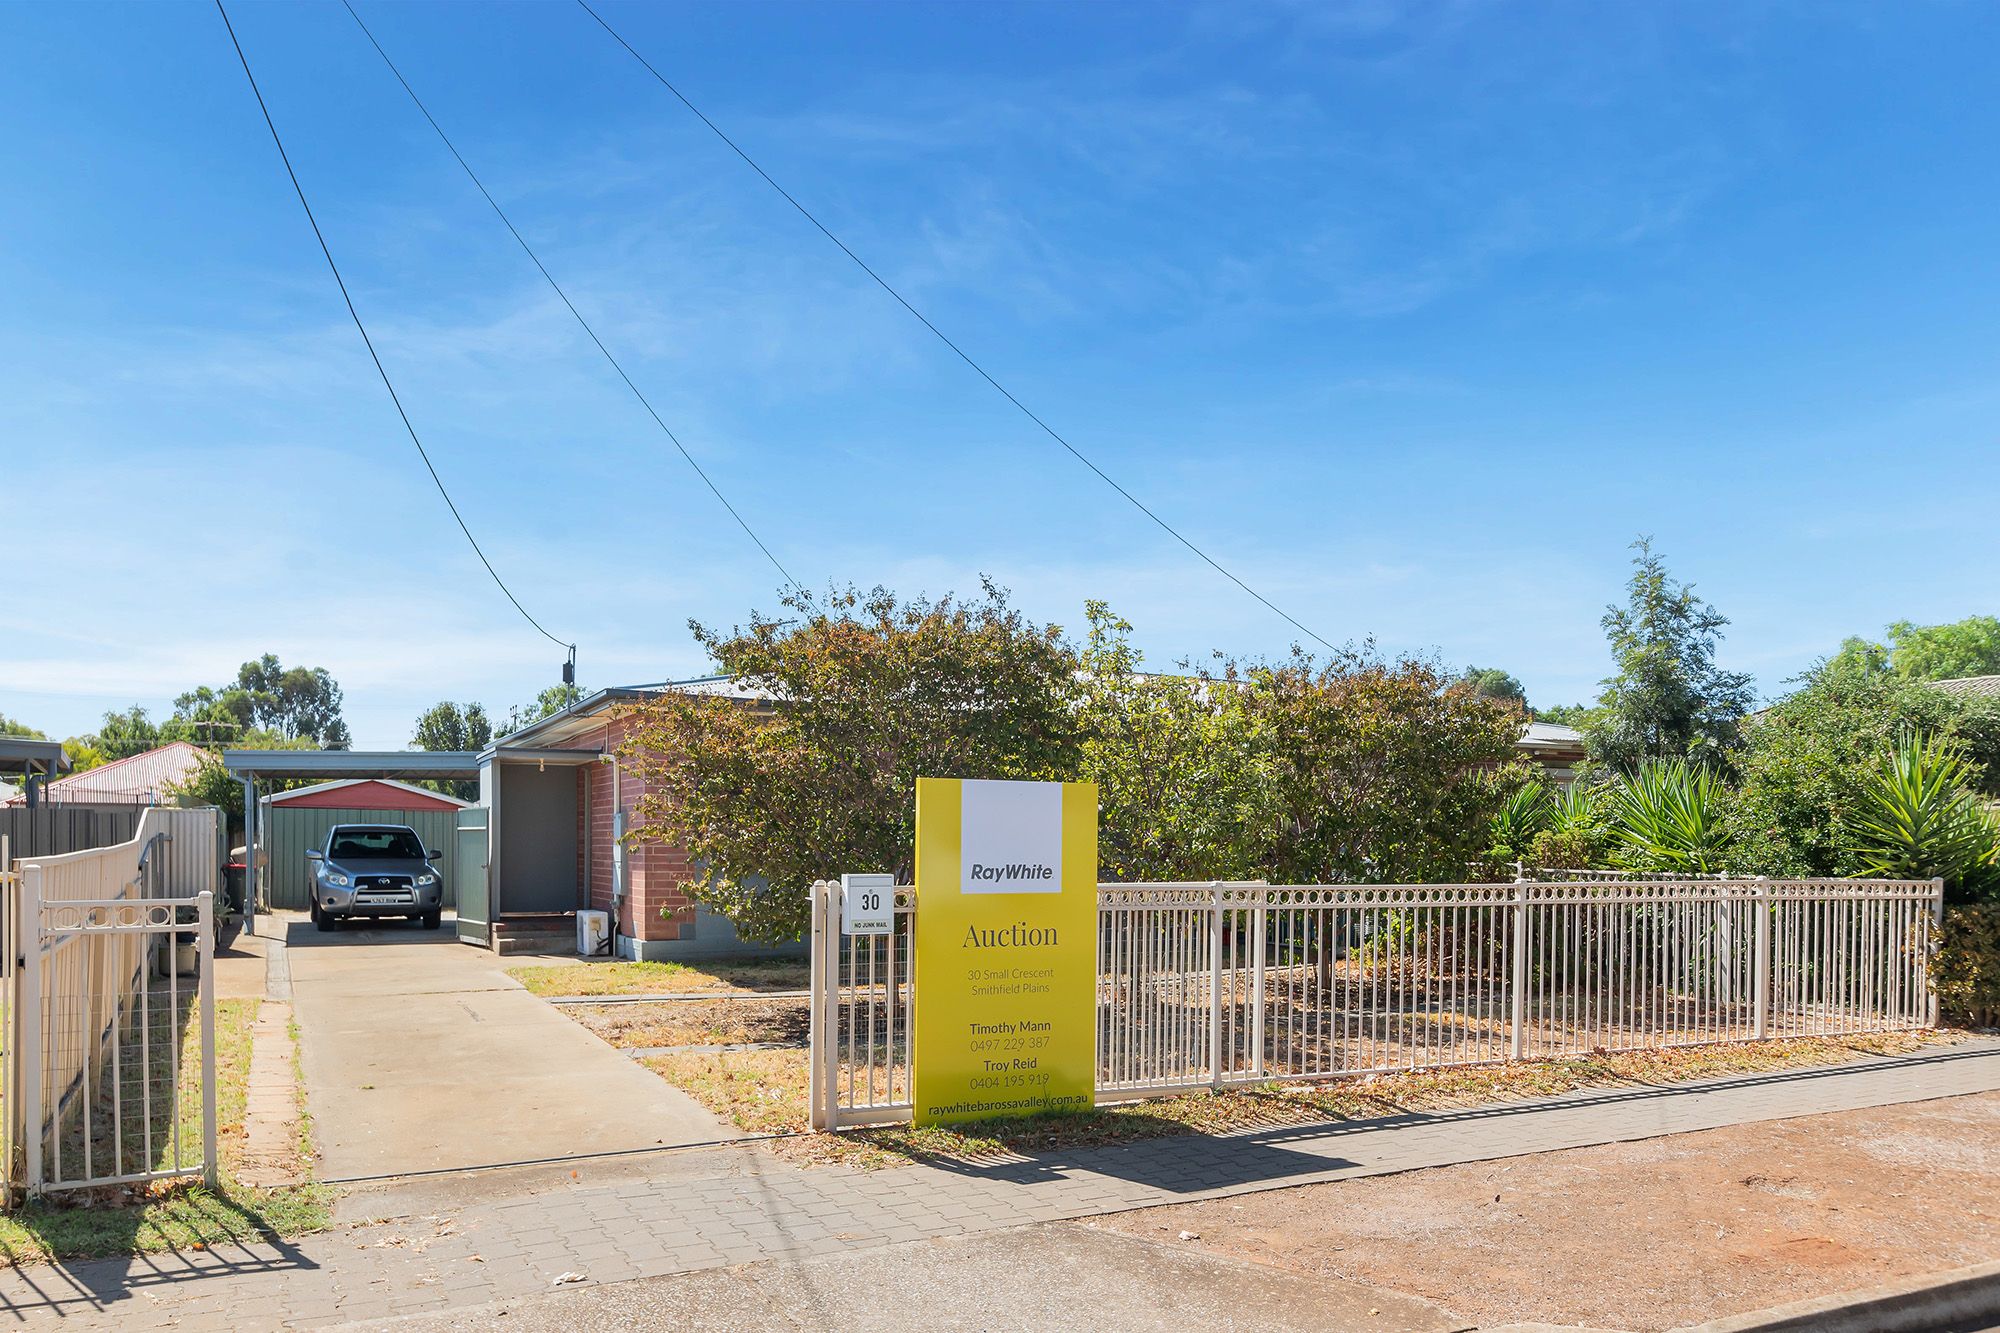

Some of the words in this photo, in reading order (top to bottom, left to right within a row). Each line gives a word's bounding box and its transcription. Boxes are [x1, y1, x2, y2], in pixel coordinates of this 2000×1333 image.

[862, 894, 879, 910] 30
[962, 922, 1058, 948] Auction
[967, 970, 981, 981] 30
[983, 969, 1009, 980] Small
[1011, 968, 1054, 979] Crescent
[971, 984, 1020, 996] Smithfield
[1022, 983, 1050, 994] Plains
[970, 1022, 1016, 1035] Timothy
[1019, 1020, 1051, 1032] Mann
[970, 1039, 1000, 1052] 0497
[1003, 1038, 1025, 1050] 229
[1028, 1036, 1050, 1049] 387
[983, 1060, 1010, 1073] Troy
[1013, 1058, 1037, 1070] Reid
[970, 1076, 1000, 1090] 0404
[1004, 1075, 1025, 1088] 195
[1028, 1073, 1050, 1086] 919
